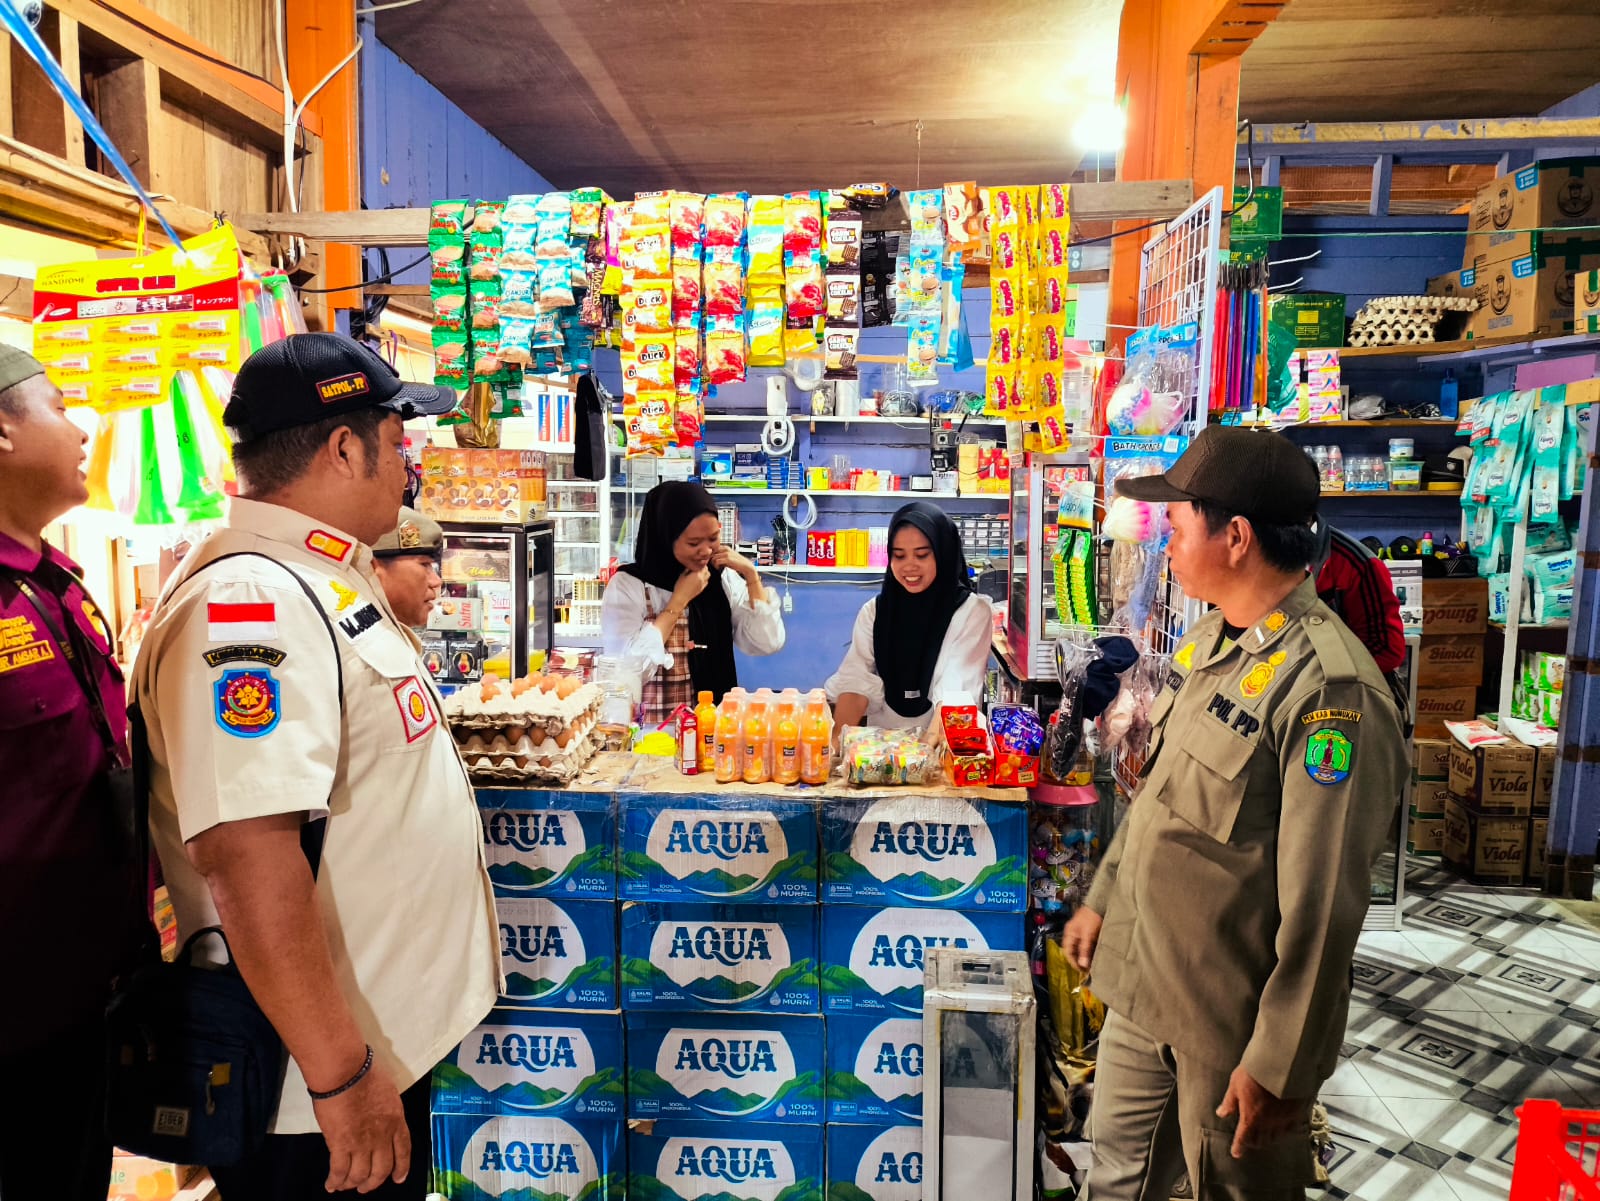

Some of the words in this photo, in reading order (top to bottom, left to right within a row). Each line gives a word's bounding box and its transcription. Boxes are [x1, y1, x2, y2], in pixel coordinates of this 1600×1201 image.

[641, 351, 665, 361] DUCK
[1113, 442, 1137, 451] BATH
[1428, 647, 1476, 660] Bimoli
[1206, 692, 1237, 724] POL
[1230, 709, 1260, 738] PP
[1418, 699, 1465, 713] Bimoli
[1451, 752, 1474, 779] Viola
[1488, 775, 1530, 793] Viola
[665, 820, 770, 861] AQUA
[870, 821, 977, 862] AQUA
[1481, 844, 1522, 861] Viola
[990, 890, 1017, 898] 100%
[668, 926, 772, 967] AQUA
[578, 995, 608, 1003] MURNI
[782, 998, 812, 1006] MURNI
[475, 1033, 578, 1073] AQUA
[674, 1038, 777, 1079] AQUA
[479, 1140, 580, 1179] AQUA
[674, 1145, 777, 1184] AQUA
